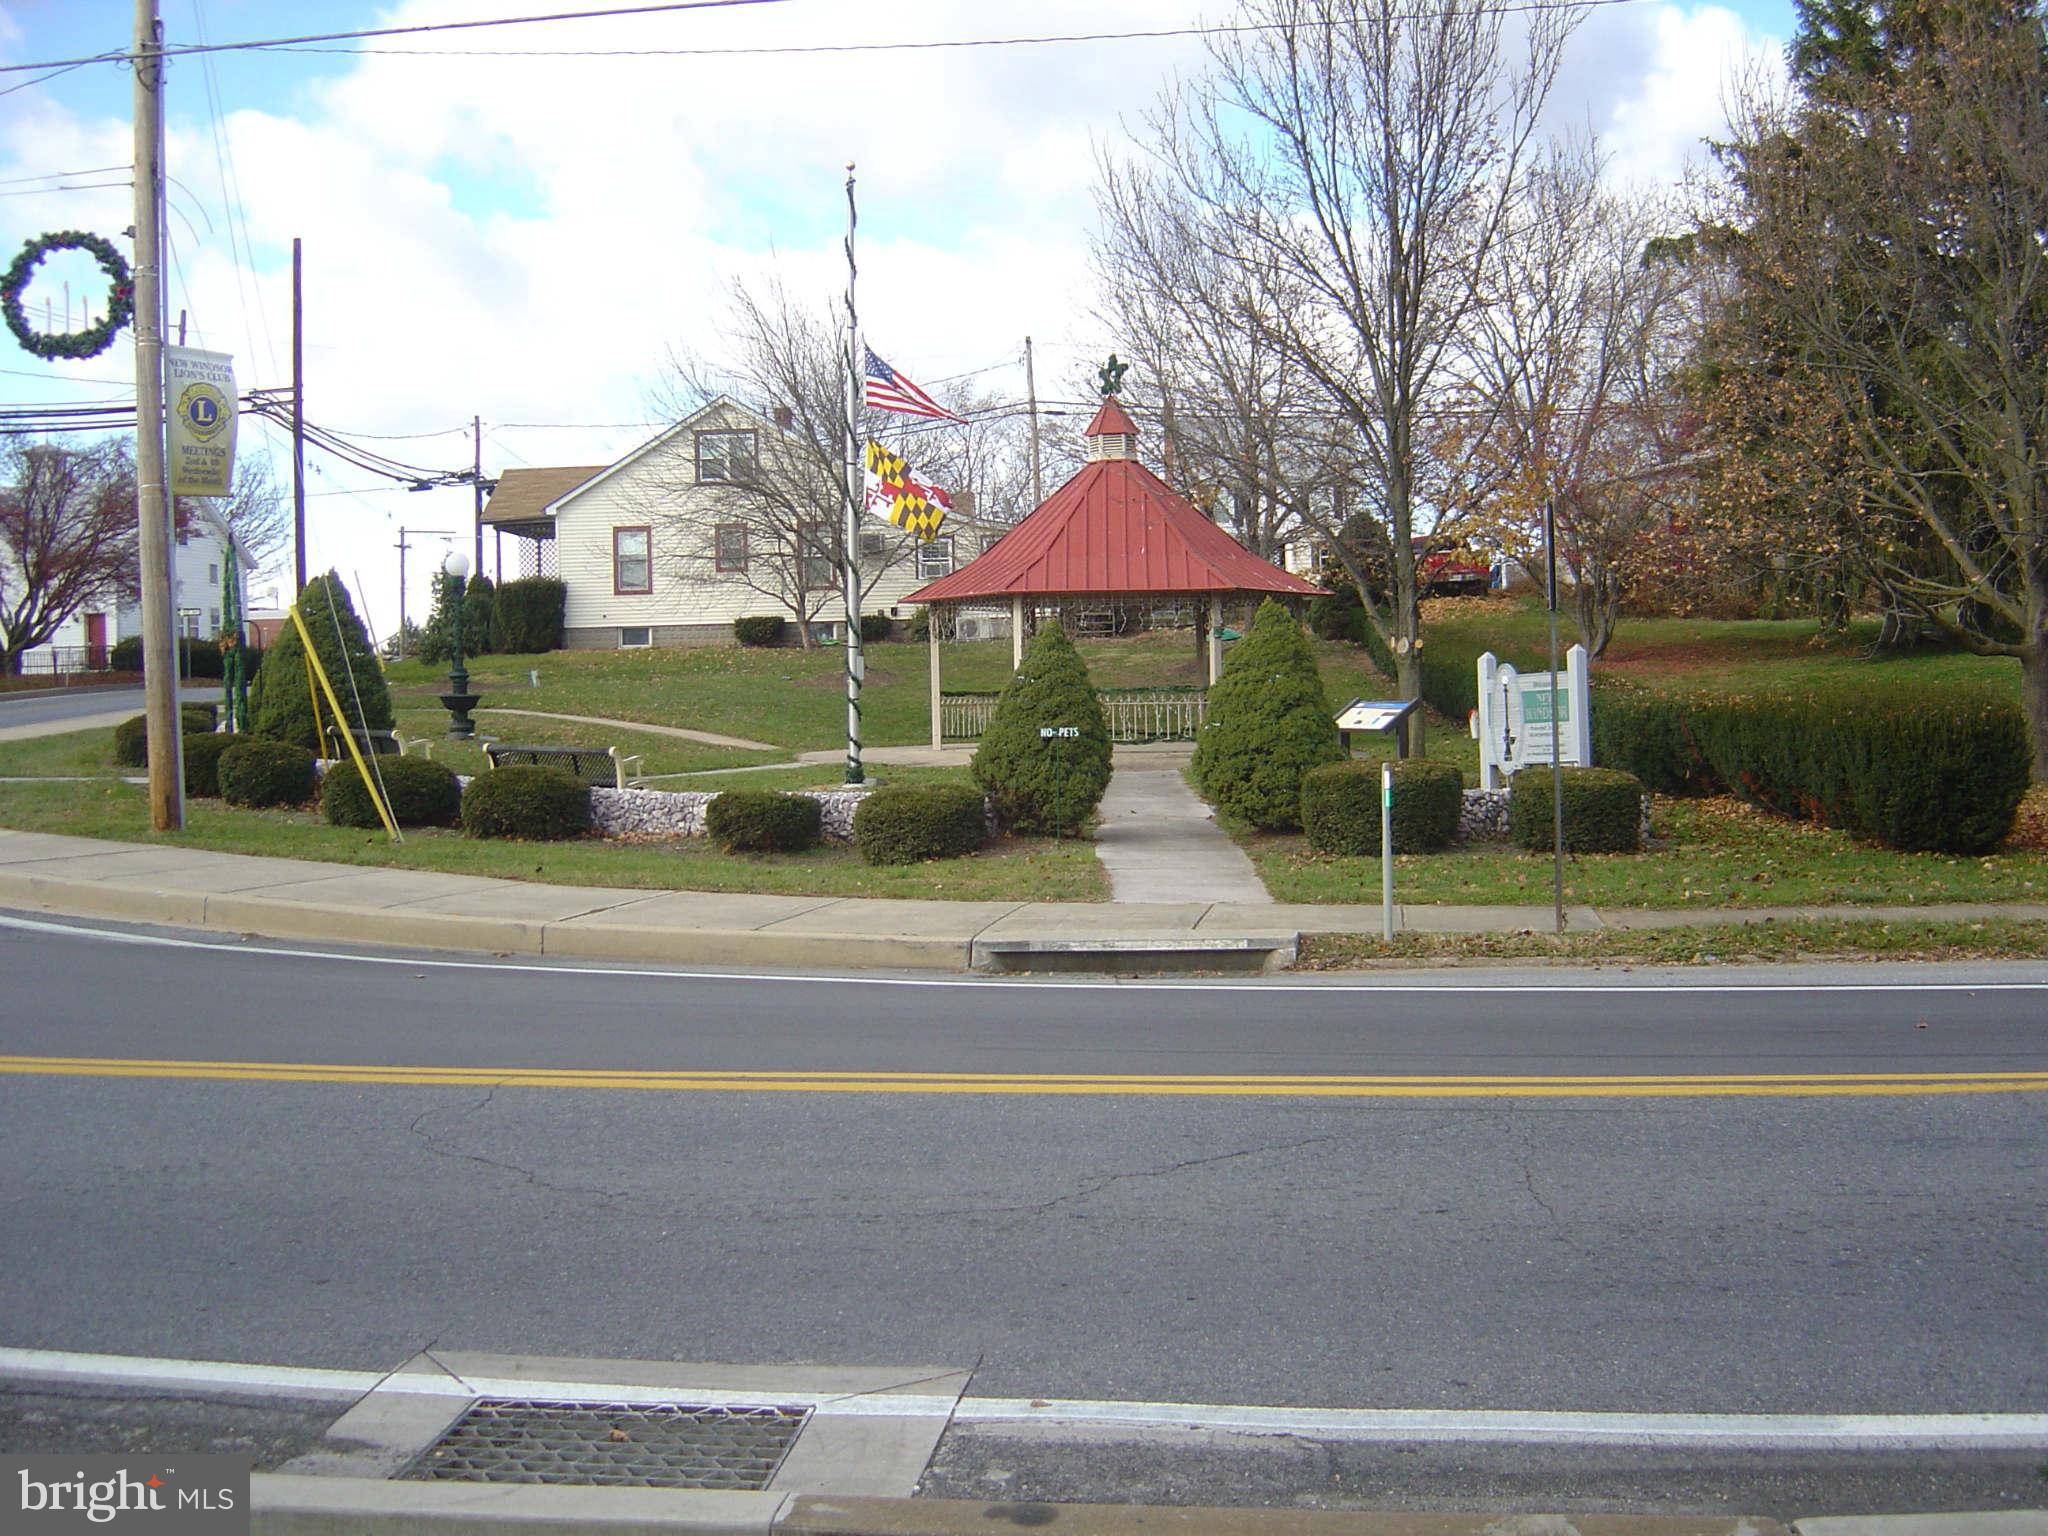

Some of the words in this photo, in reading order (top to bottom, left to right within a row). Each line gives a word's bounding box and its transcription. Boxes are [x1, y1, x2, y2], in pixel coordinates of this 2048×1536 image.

[169, 359, 188, 368] NEW
[197, 400, 213, 421] L
[182, 445, 226, 457] MEETINGS
